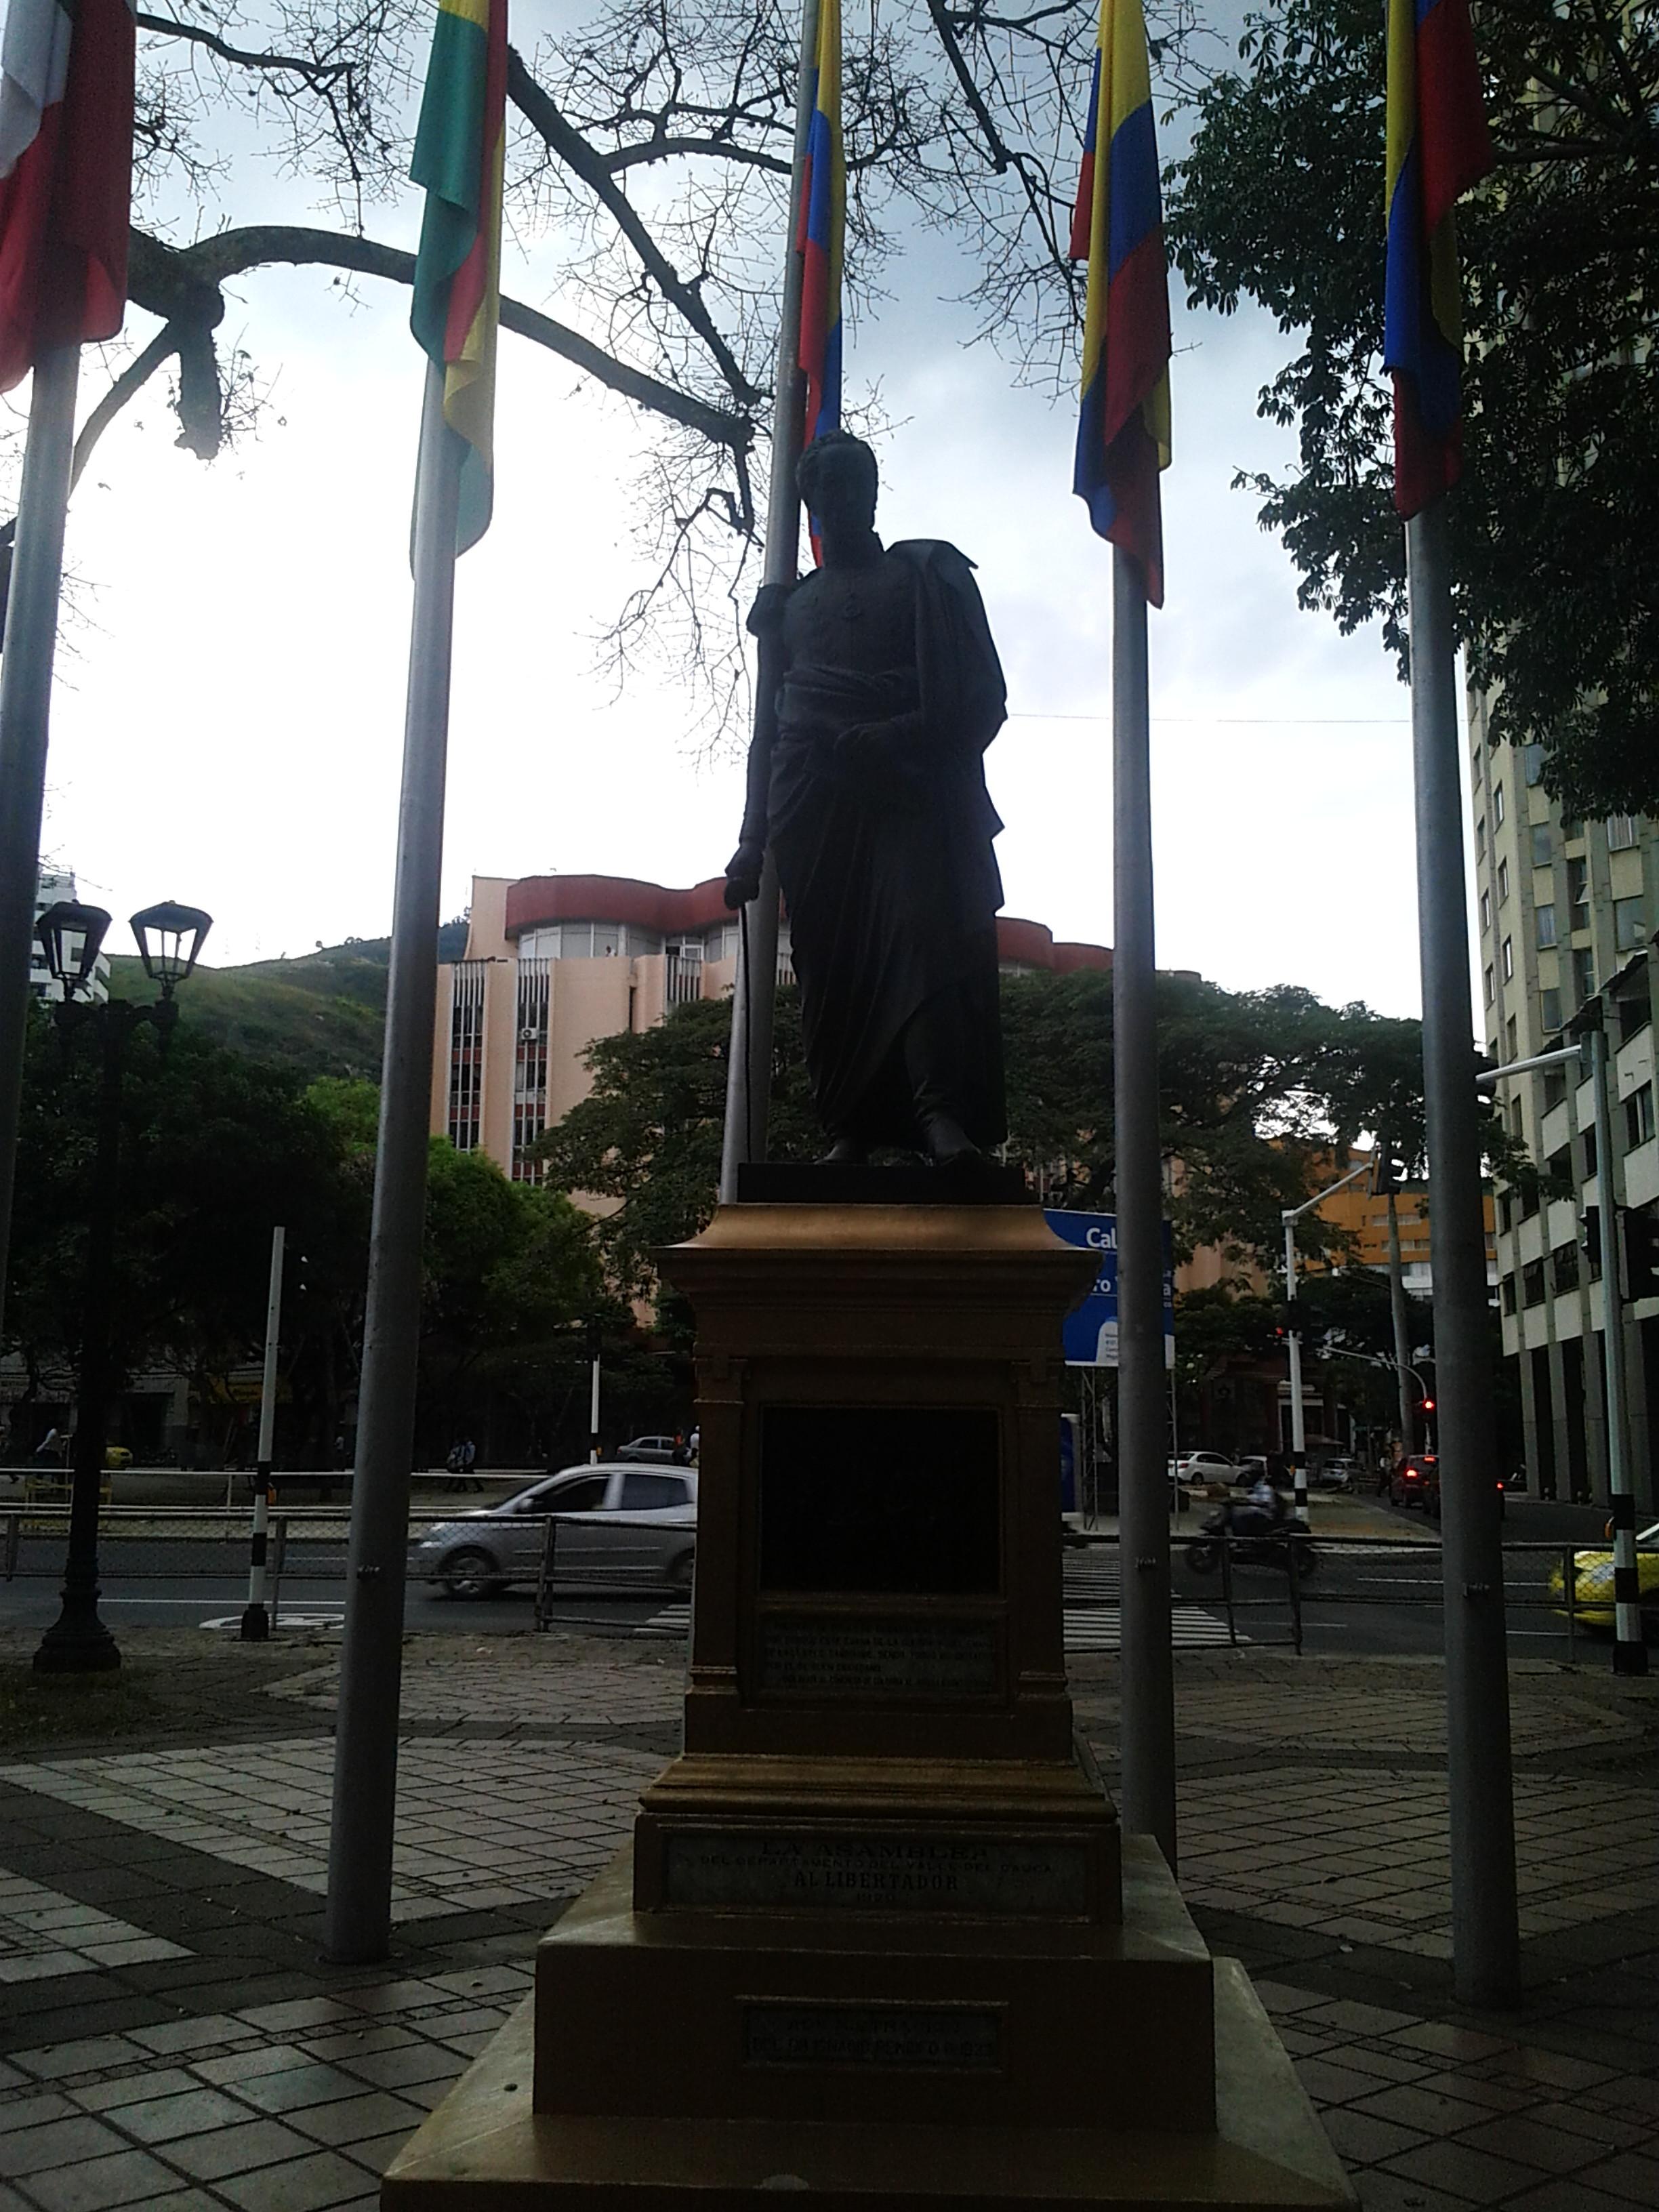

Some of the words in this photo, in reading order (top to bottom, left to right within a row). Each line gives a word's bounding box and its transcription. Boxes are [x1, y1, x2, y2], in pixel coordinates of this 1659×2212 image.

[1086, 1227, 1118, 1249] Cal
[762, 1841, 799, 1856] LA
[819, 1843, 987, 1860] ASAMBLEA
[795, 1870, 819, 1887] AL
[824, 1872, 958, 1890] LIBERTADOR
